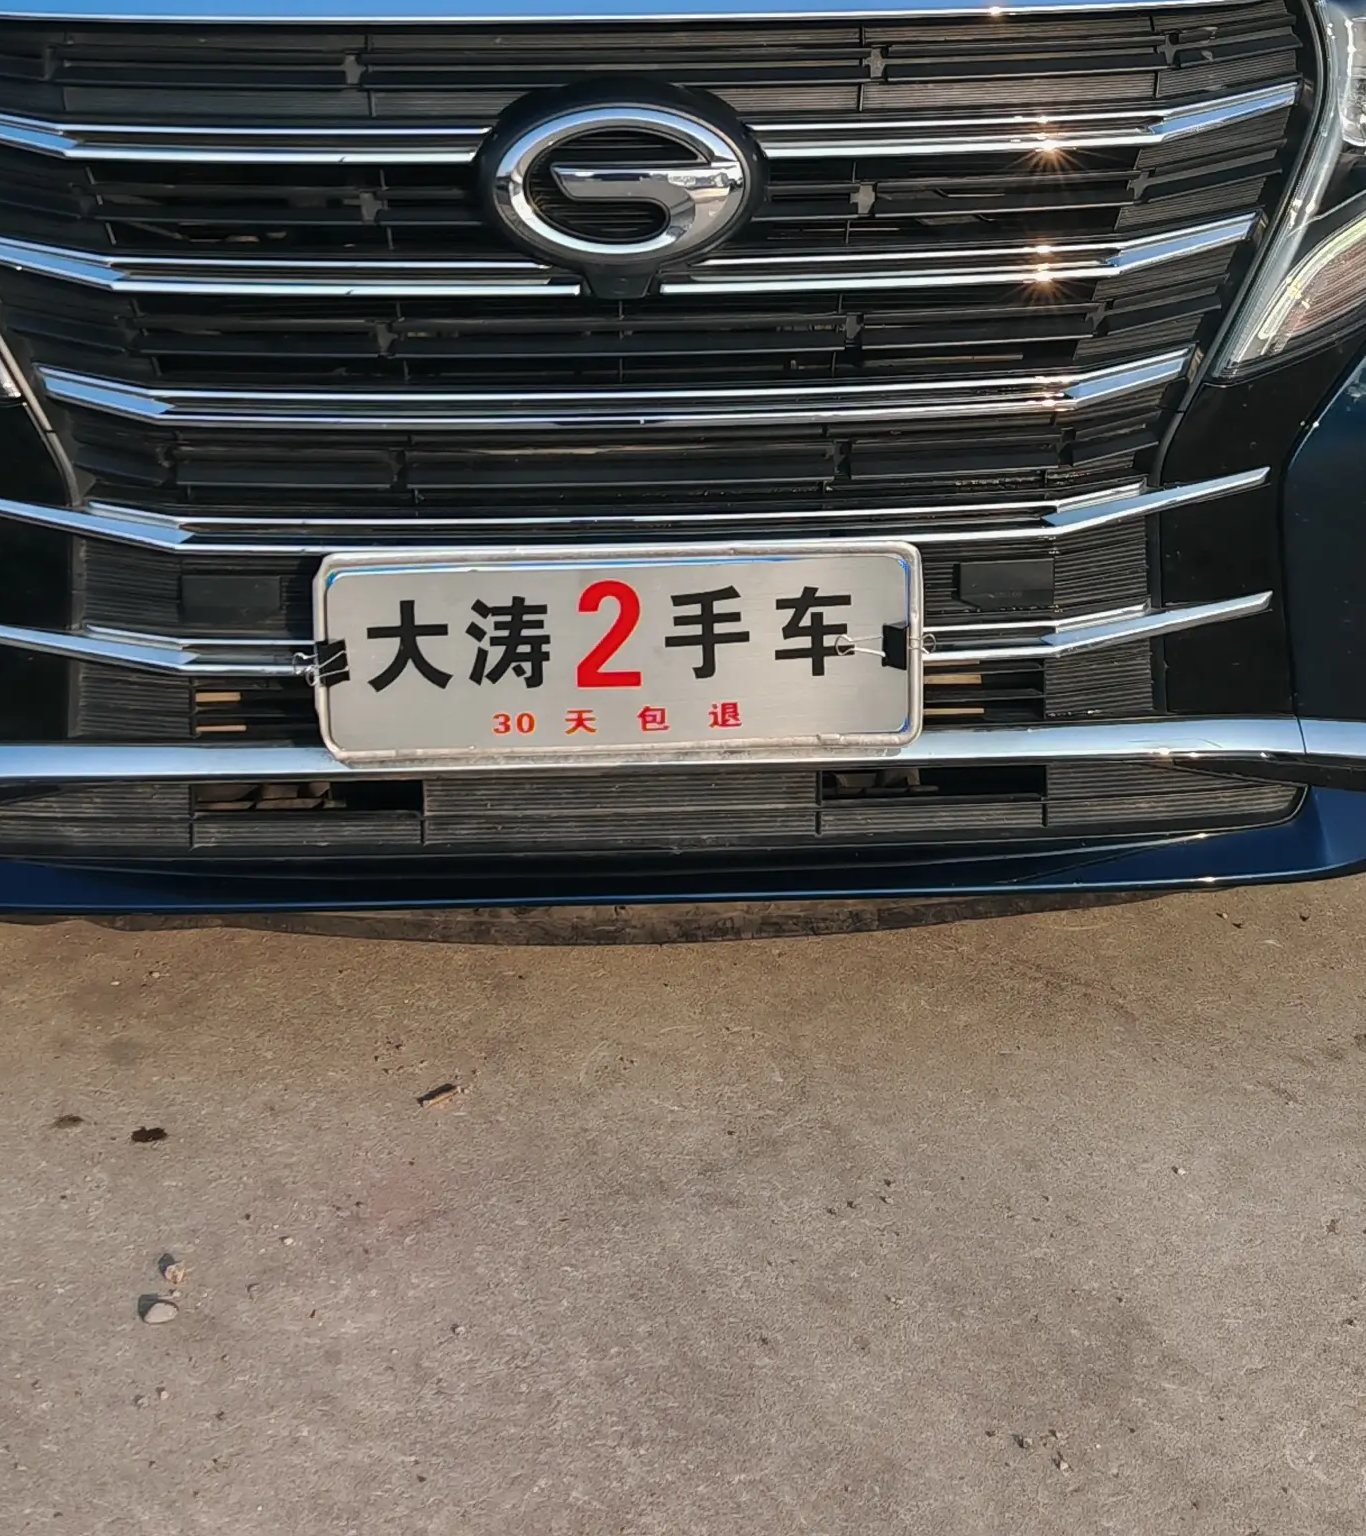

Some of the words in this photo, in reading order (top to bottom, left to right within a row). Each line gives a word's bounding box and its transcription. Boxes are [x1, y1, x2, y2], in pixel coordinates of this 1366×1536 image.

[366, 579, 853, 693] 大涛2手车
[493, 701, 743, 735] 30天包退
